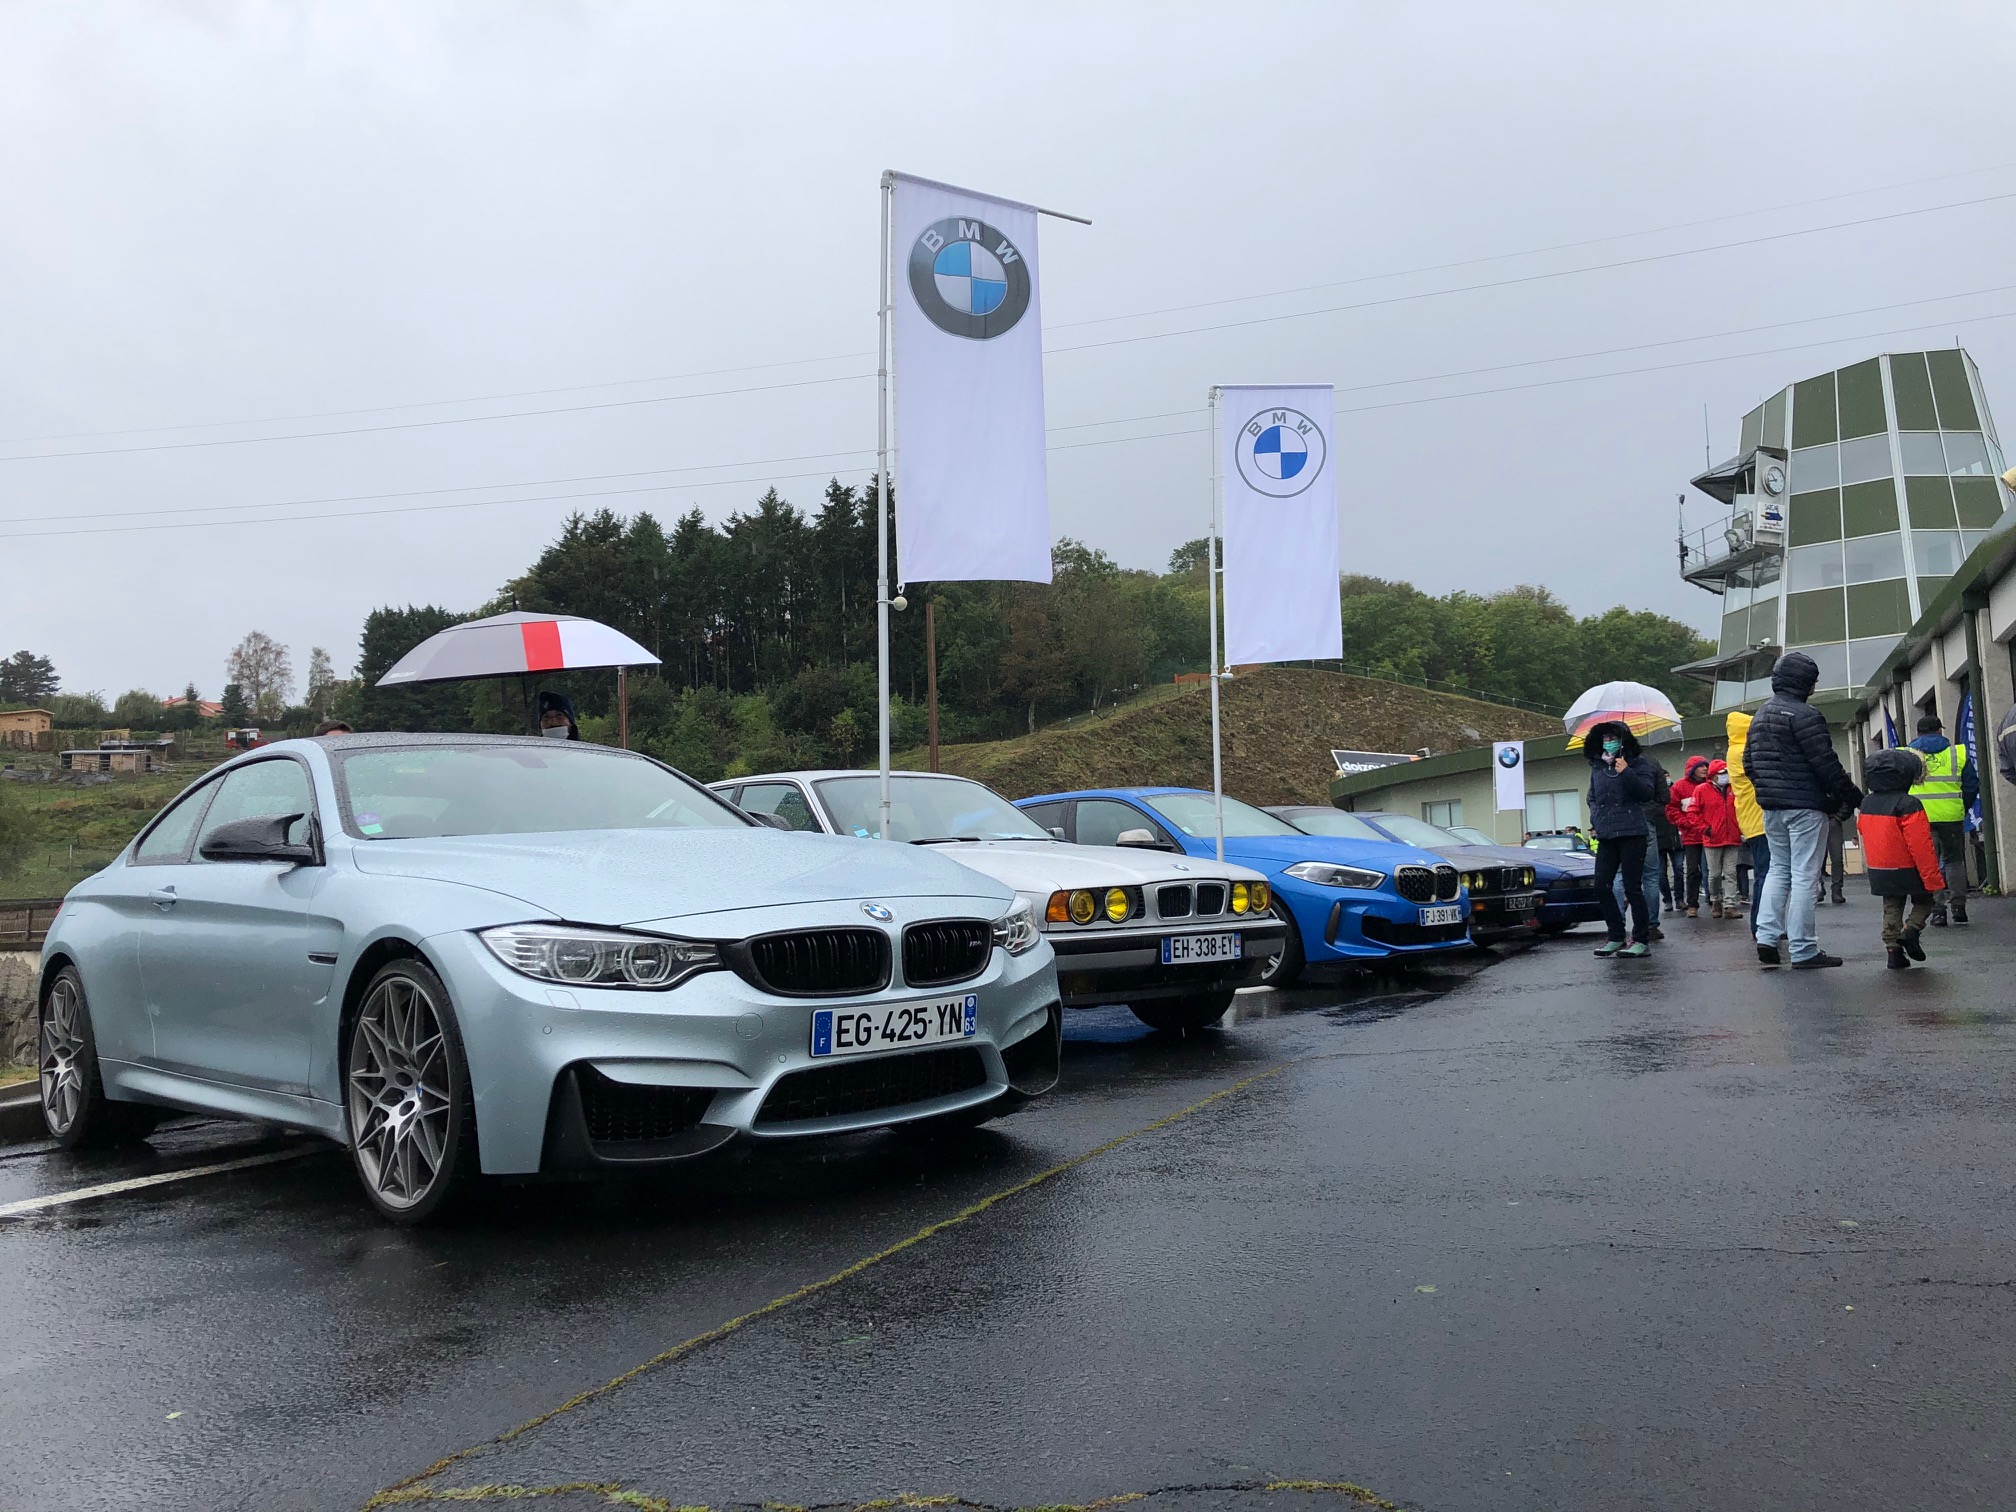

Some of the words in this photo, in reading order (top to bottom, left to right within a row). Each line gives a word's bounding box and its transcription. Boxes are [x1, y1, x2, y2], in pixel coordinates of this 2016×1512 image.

[920, 220, 1019, 265] BMW
[1247, 411, 1313, 438] BMW
[1173, 935, 1233, 958] EH-338-EY
[820, 1037, 826, 1048] F
[836, 1002, 963, 1048] EG-425-YN
[965, 1017, 976, 1032] 63
